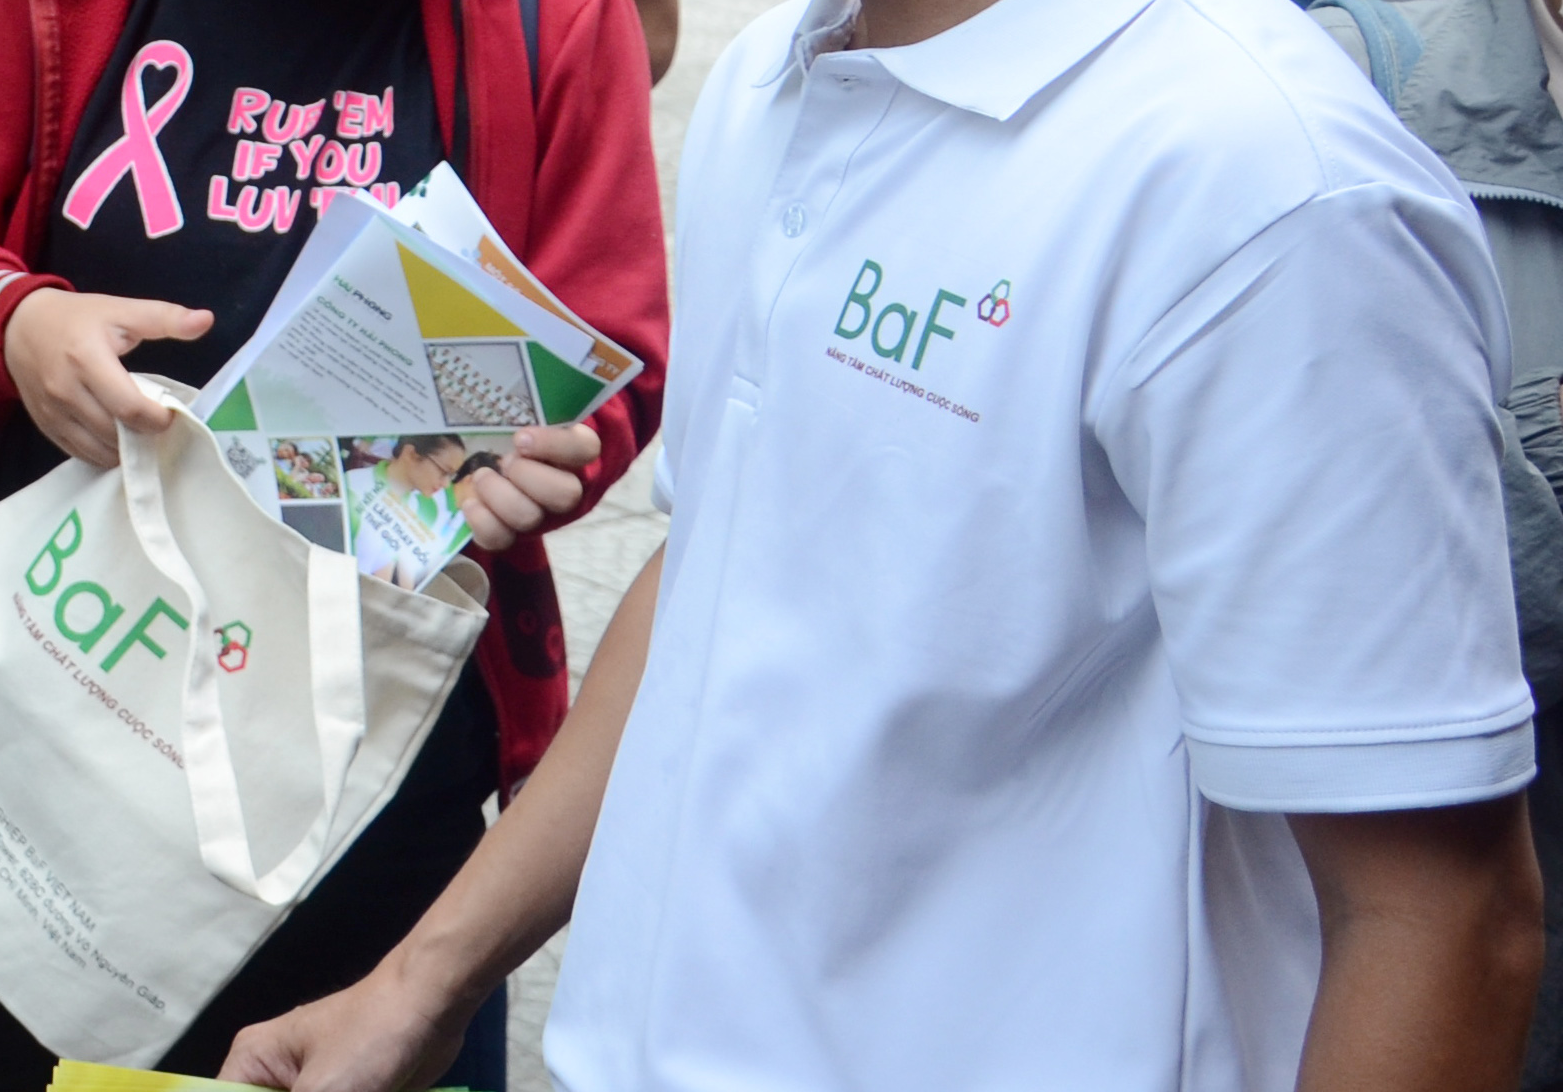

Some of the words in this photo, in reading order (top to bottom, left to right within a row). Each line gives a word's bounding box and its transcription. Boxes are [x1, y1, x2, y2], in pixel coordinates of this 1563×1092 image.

[332, 85, 394, 140] 'EM
[232, 140, 283, 182] IF
[289, 134, 382, 187] YOU
[207, 175, 302, 234] LUV
[832, 258, 967, 371] BaF
[24, 508, 190, 674] BaF
[68, 899, 97, 933] NAM
